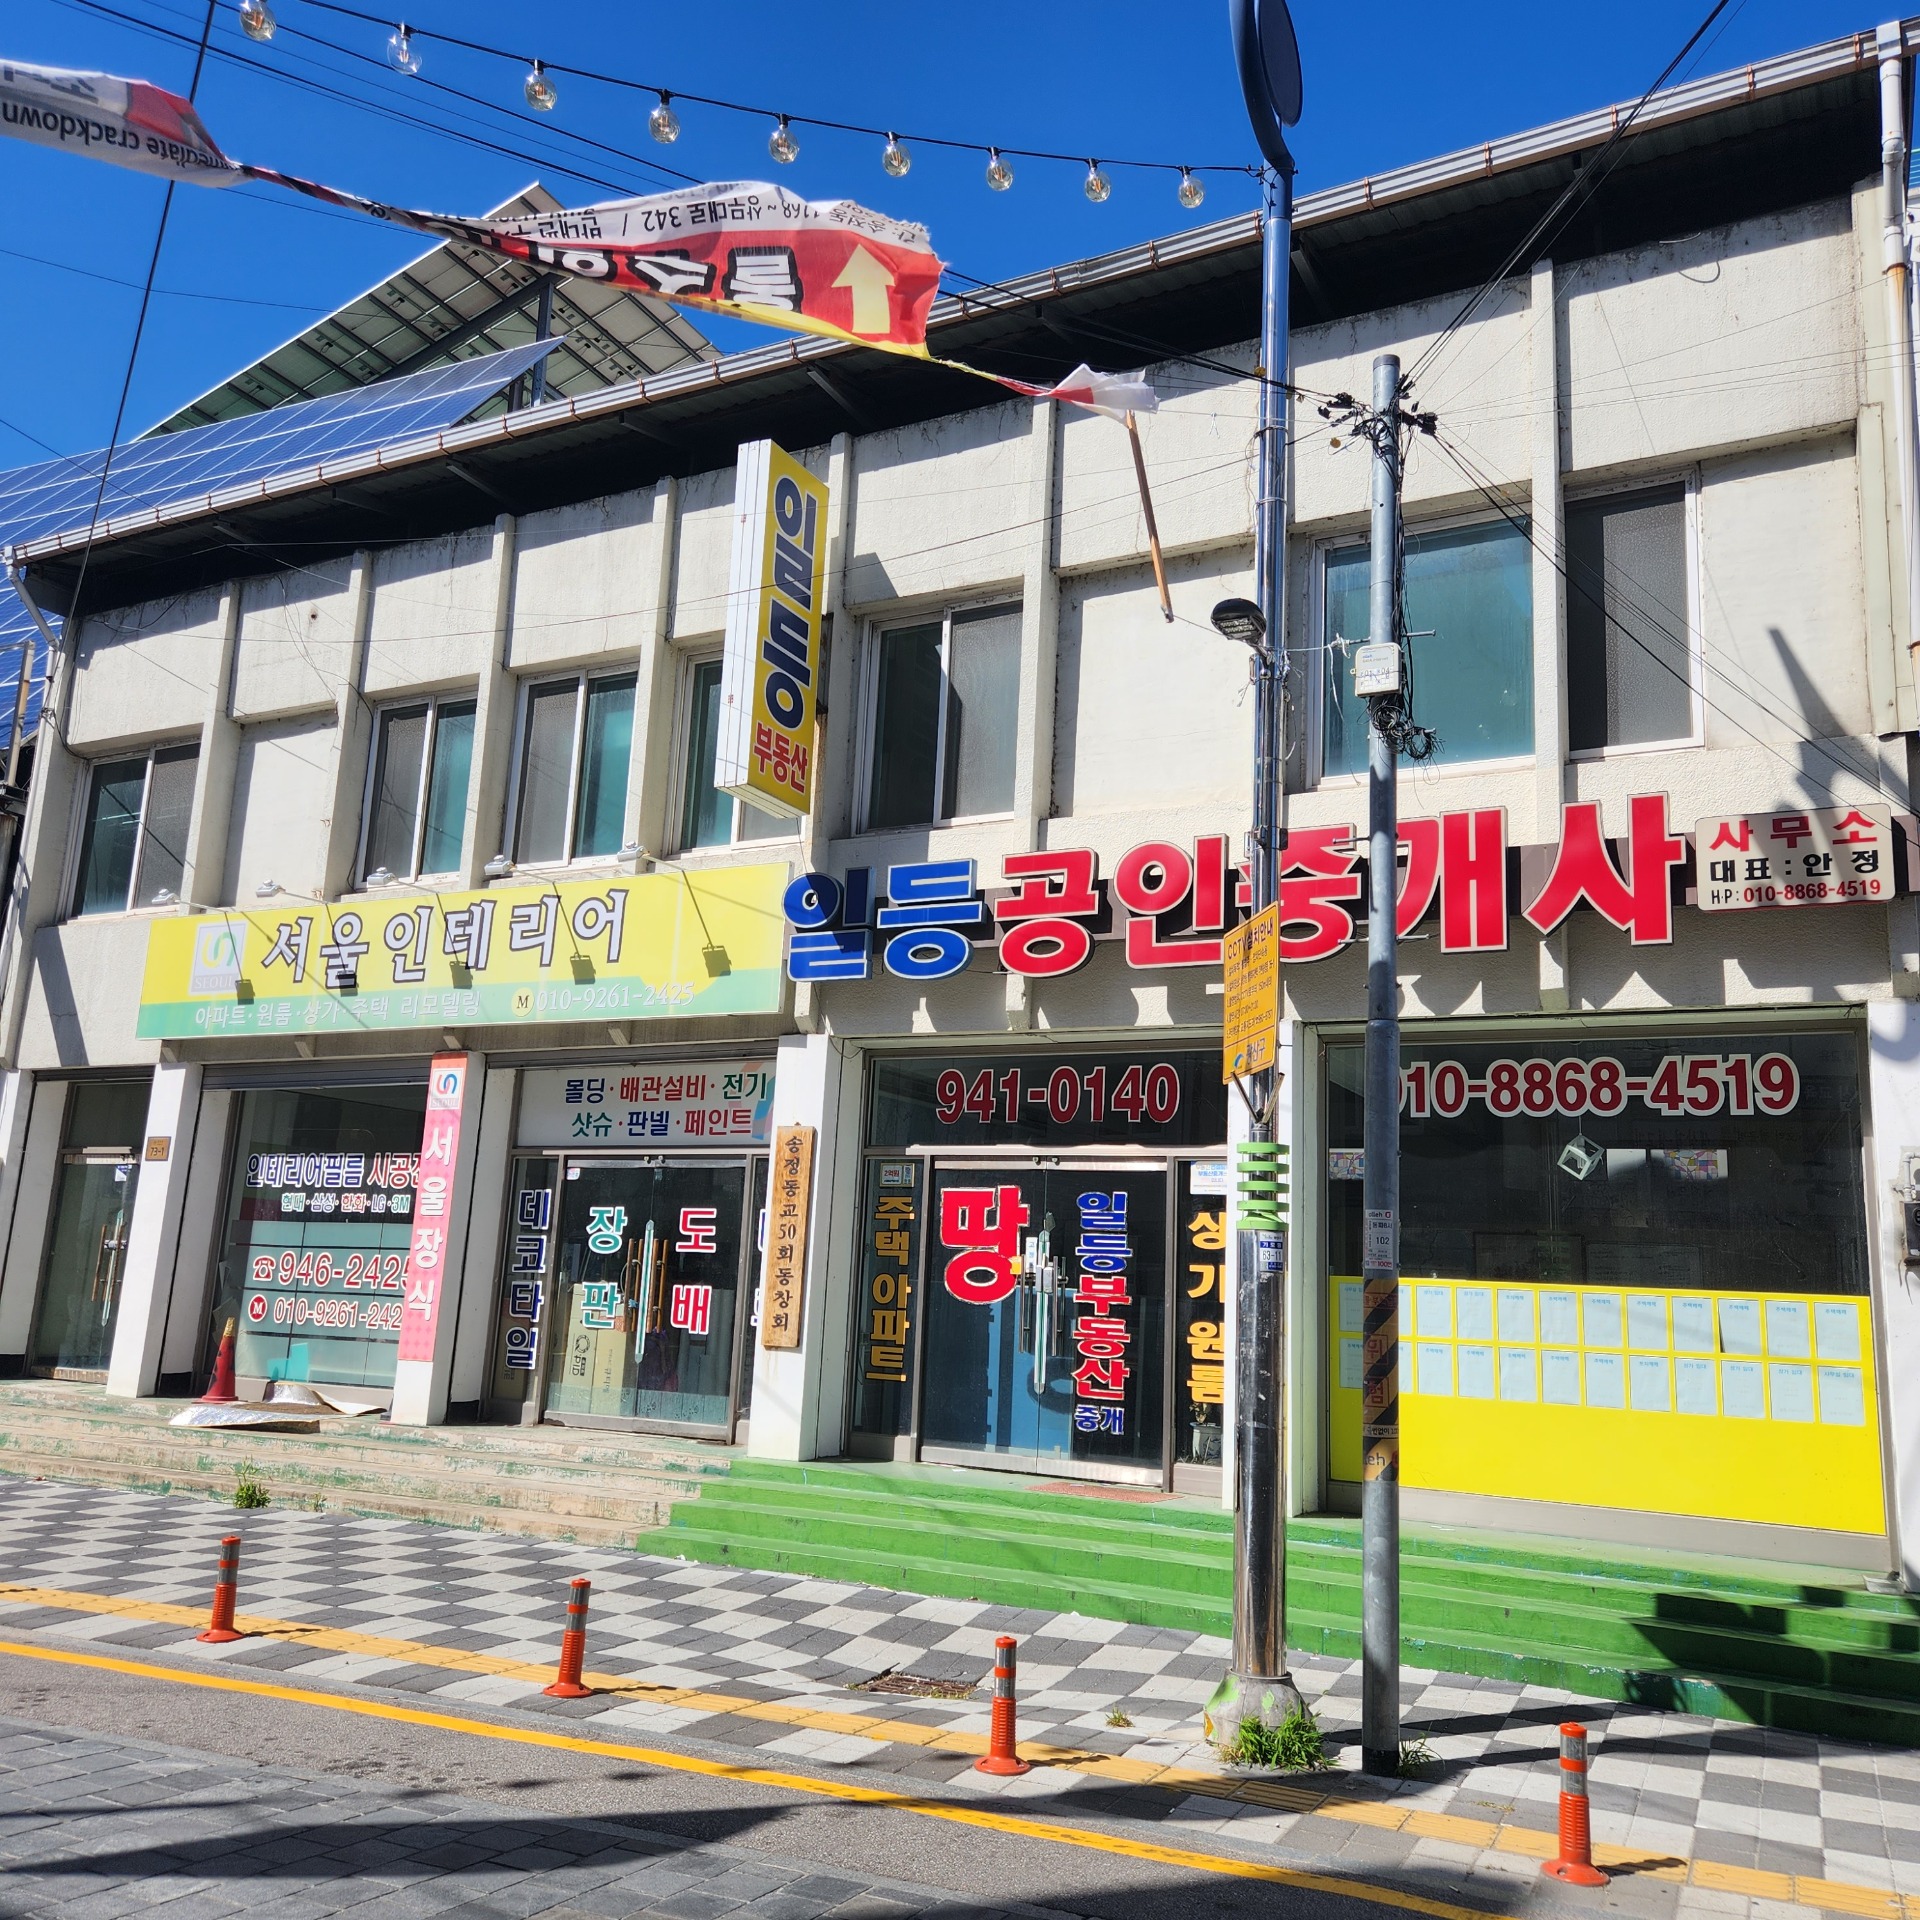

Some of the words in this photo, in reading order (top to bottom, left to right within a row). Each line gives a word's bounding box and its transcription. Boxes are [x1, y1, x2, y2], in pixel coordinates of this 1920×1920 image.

[2, 102, 141, 151] crackdown
[641, 205, 682, 233] 342
[686, 194, 763, 227] 상무대로
[761, 474, 818, 732] 일등
[752, 720, 809, 795] 부동산
[1709, 810, 1878, 853] 사무소
[1743, 879, 1881, 904] 010-8868-4519
[400, 990, 480, 1019] 리모델링
[536, 981, 696, 1013] 010-9261-2425
[935, 1063, 1180, 1125] 941-0140
[1398, 1052, 1801, 1118] 10-8868-4519
[150, 1146, 165, 1157] 73-1
[246, 1152, 365, 1188] 인테리어필름
[407, 1125, 453, 1322] 서울장식
[873, 1195, 916, 1267] 주택
[939, 1183, 1030, 1306] 땅
[1376, 1236, 1390, 1245] 102
[1262, 1250, 1282, 1261] 63-11
[505, 1188, 552, 1370] 데코타일
[864, 1272, 912, 1384] 아파트
[1073, 1403, 1126, 1436] 중개
